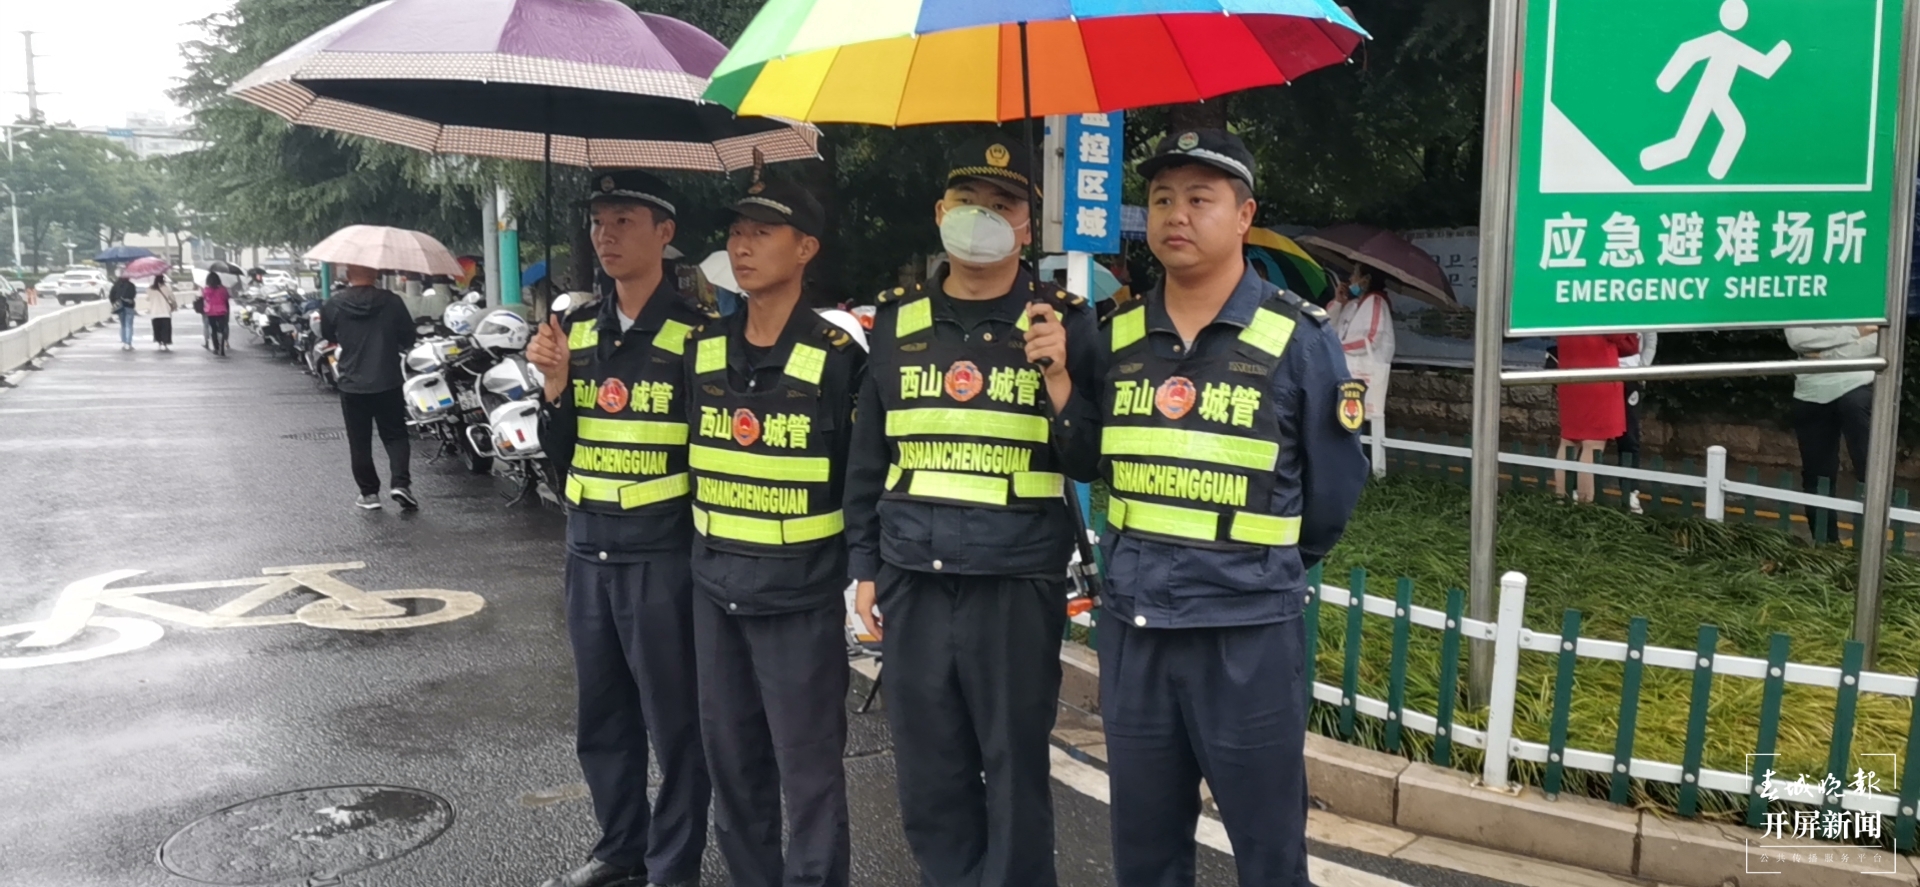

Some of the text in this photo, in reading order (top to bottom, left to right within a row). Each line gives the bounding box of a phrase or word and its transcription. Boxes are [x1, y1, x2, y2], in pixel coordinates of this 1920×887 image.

[1539, 210, 1867, 271] 应急避难场所
[1556, 274, 1828, 304] EMERGENCY SHELTER
[630, 381, 673, 414] 城管
[900, 364, 1041, 406] 西山 城管
[1113, 379, 1261, 428] 西山 城管
[699, 406, 811, 449] 西山 城管
